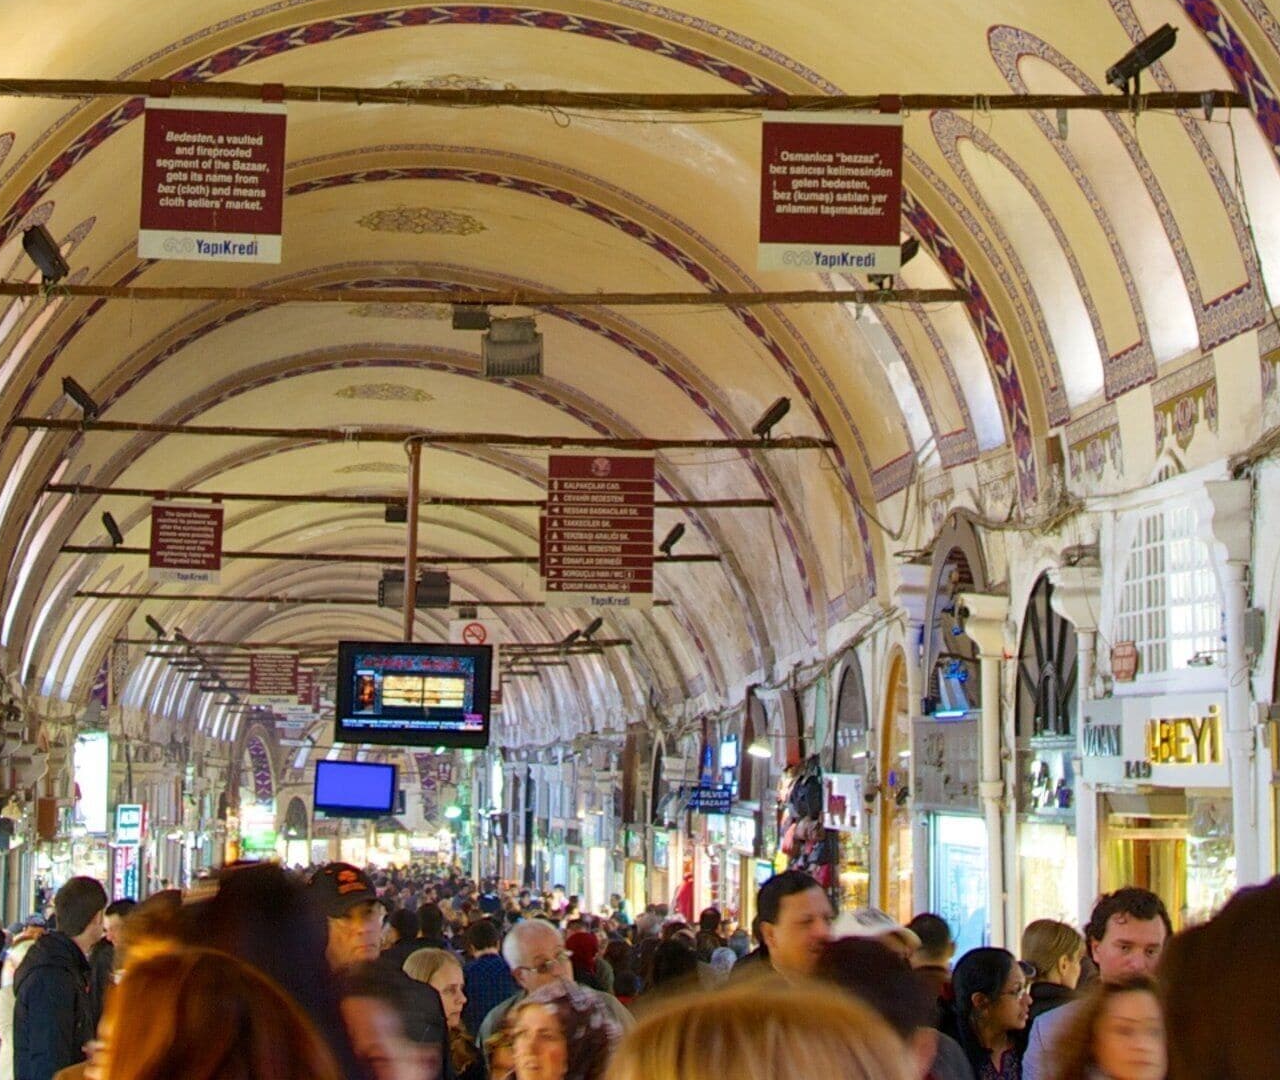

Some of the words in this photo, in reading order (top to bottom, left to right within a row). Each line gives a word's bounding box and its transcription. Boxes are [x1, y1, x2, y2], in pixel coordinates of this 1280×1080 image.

[165, 131, 215, 143] Bedesten,
[217, 135, 224, 143] a
[226, 134, 263, 145] vaulted
[175, 145, 194, 155] and
[196, 145, 251, 158] fireproofed
[156, 158, 199, 169] segment
[201, 158, 212, 169] of
[213, 159, 230, 169] the
[232, 159, 269, 172] Bazaar,
[166, 171, 188, 182] gets
[190, 171, 203, 181] its
[205, 173, 232, 182] name
[234, 172, 258, 183] from
[157, 184, 177, 194] bez
[177, 184, 210, 196] (cloth)
[211, 185, 230, 195] and
[232, 187, 265, 197] means
[159, 196, 184, 206] cloth
[186, 197, 223, 208] sellers'
[225, 199, 262, 210] market.
[196, 239, 258, 257] YapıKredi
[813, 251, 876, 268] YapıKredi
[1124, 760, 1152, 779] 149
